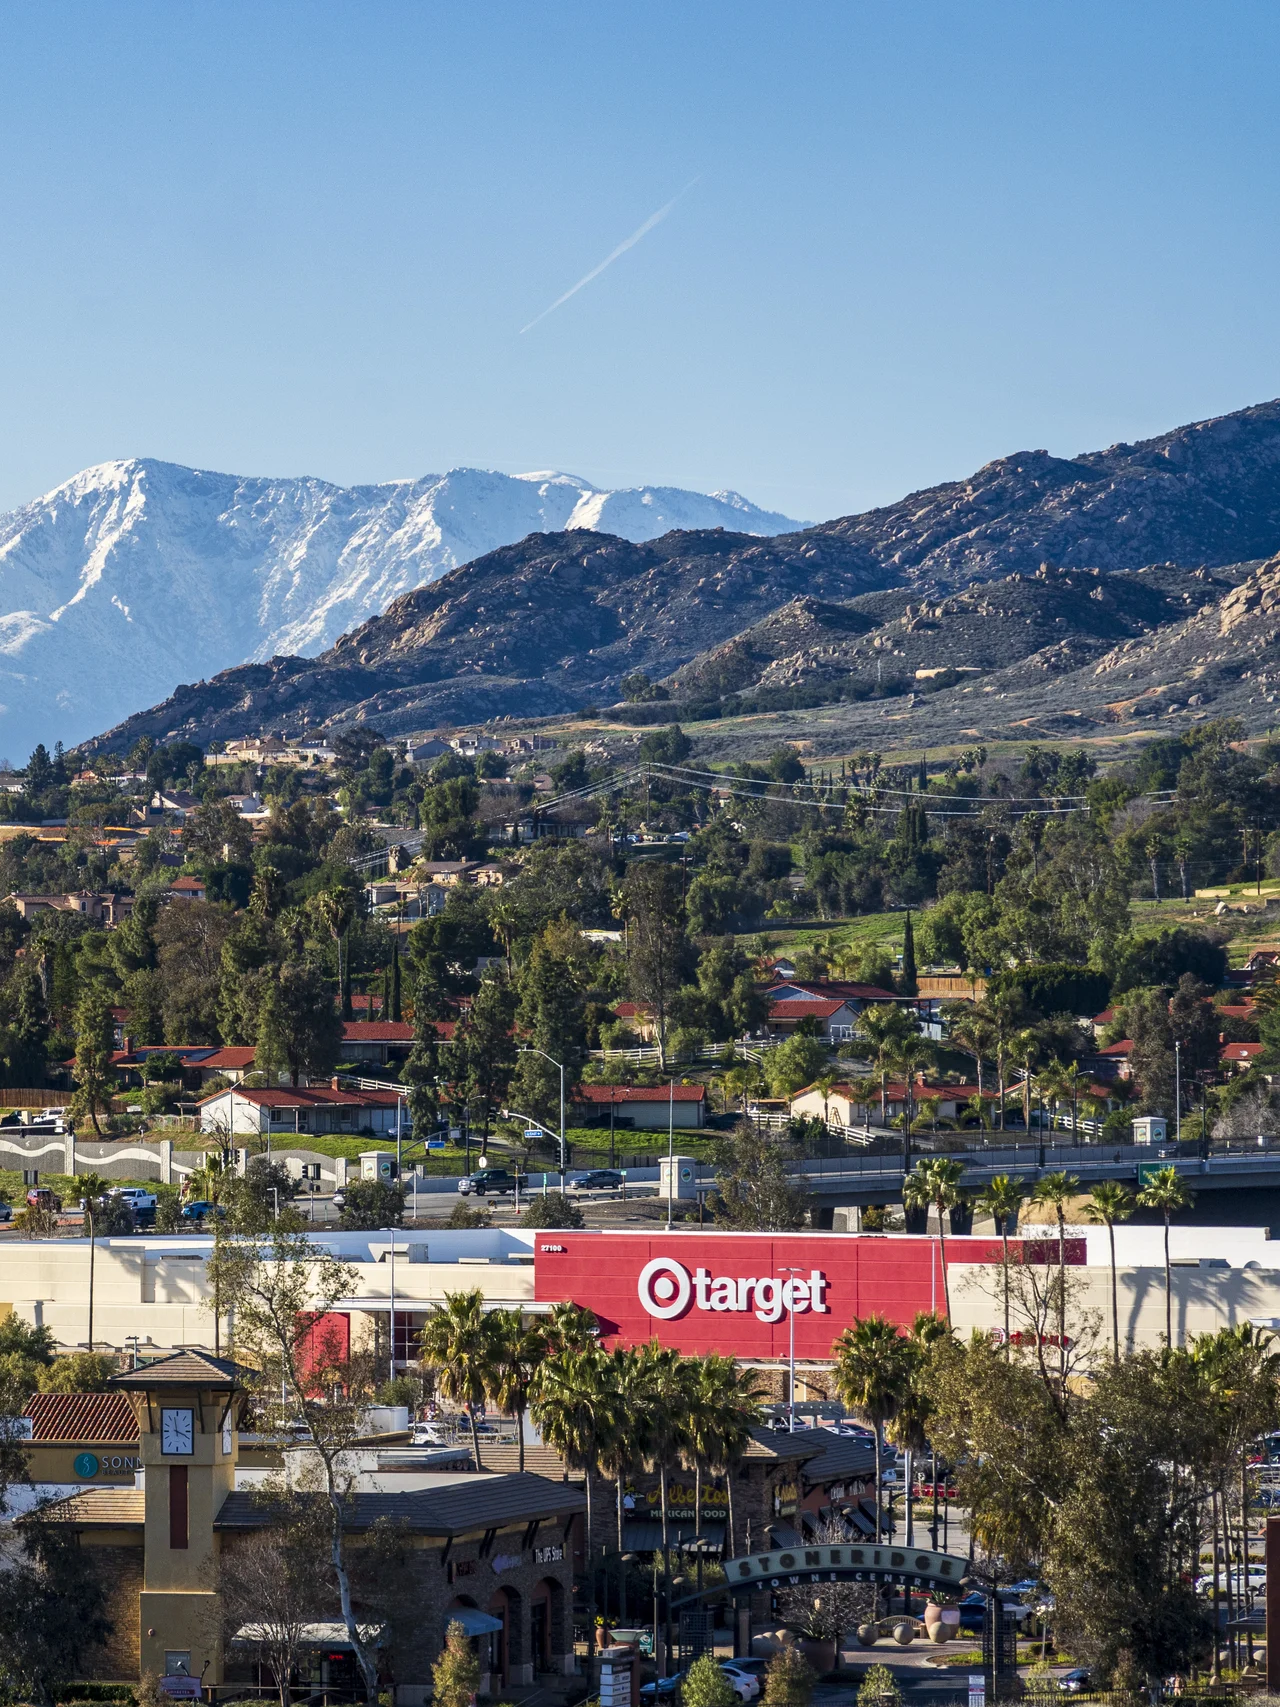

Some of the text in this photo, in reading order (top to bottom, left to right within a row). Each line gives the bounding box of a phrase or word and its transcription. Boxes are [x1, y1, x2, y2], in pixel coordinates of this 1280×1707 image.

[540, 1244, 562, 1252] 27100
[692, 1268, 826, 1322] target
[646, 1484, 729, 1504] Albetos
[535, 1549, 543, 1564] The
[543, 1547, 551, 1562] UPS
[552, 1545, 563, 1561] Store
[738, 1549, 954, 1577] STONERIDGE
[757, 1572, 936, 1590] TOWNE CENTRE
